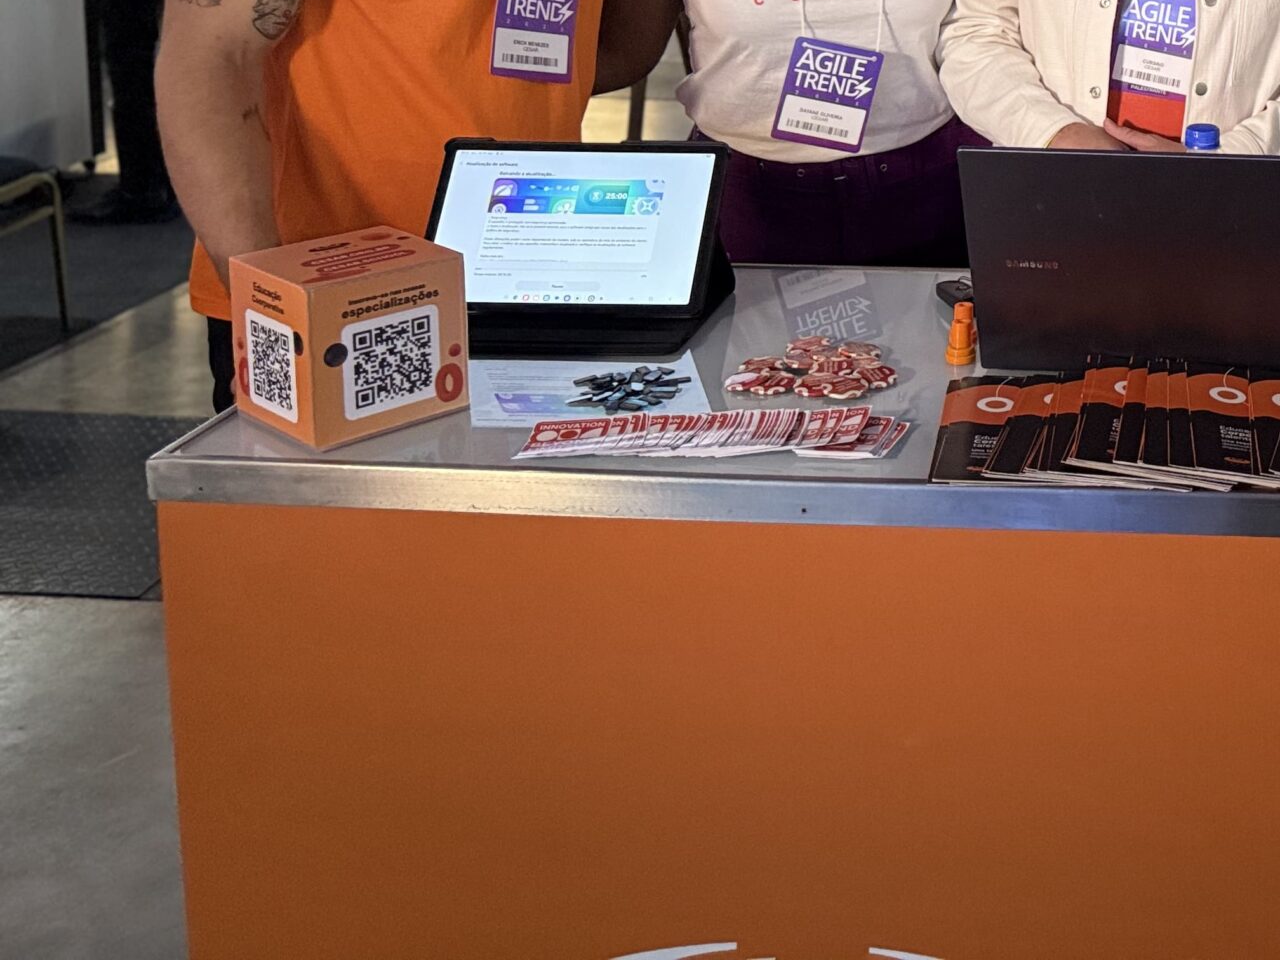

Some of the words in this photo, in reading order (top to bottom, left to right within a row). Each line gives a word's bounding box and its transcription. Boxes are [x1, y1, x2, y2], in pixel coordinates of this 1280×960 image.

[796, 48, 868, 80] AGILE
[605, 192, 628, 200] 25:00
[341, 289, 440, 319] especializações
[539, 421, 606, 430] INNOVATION
